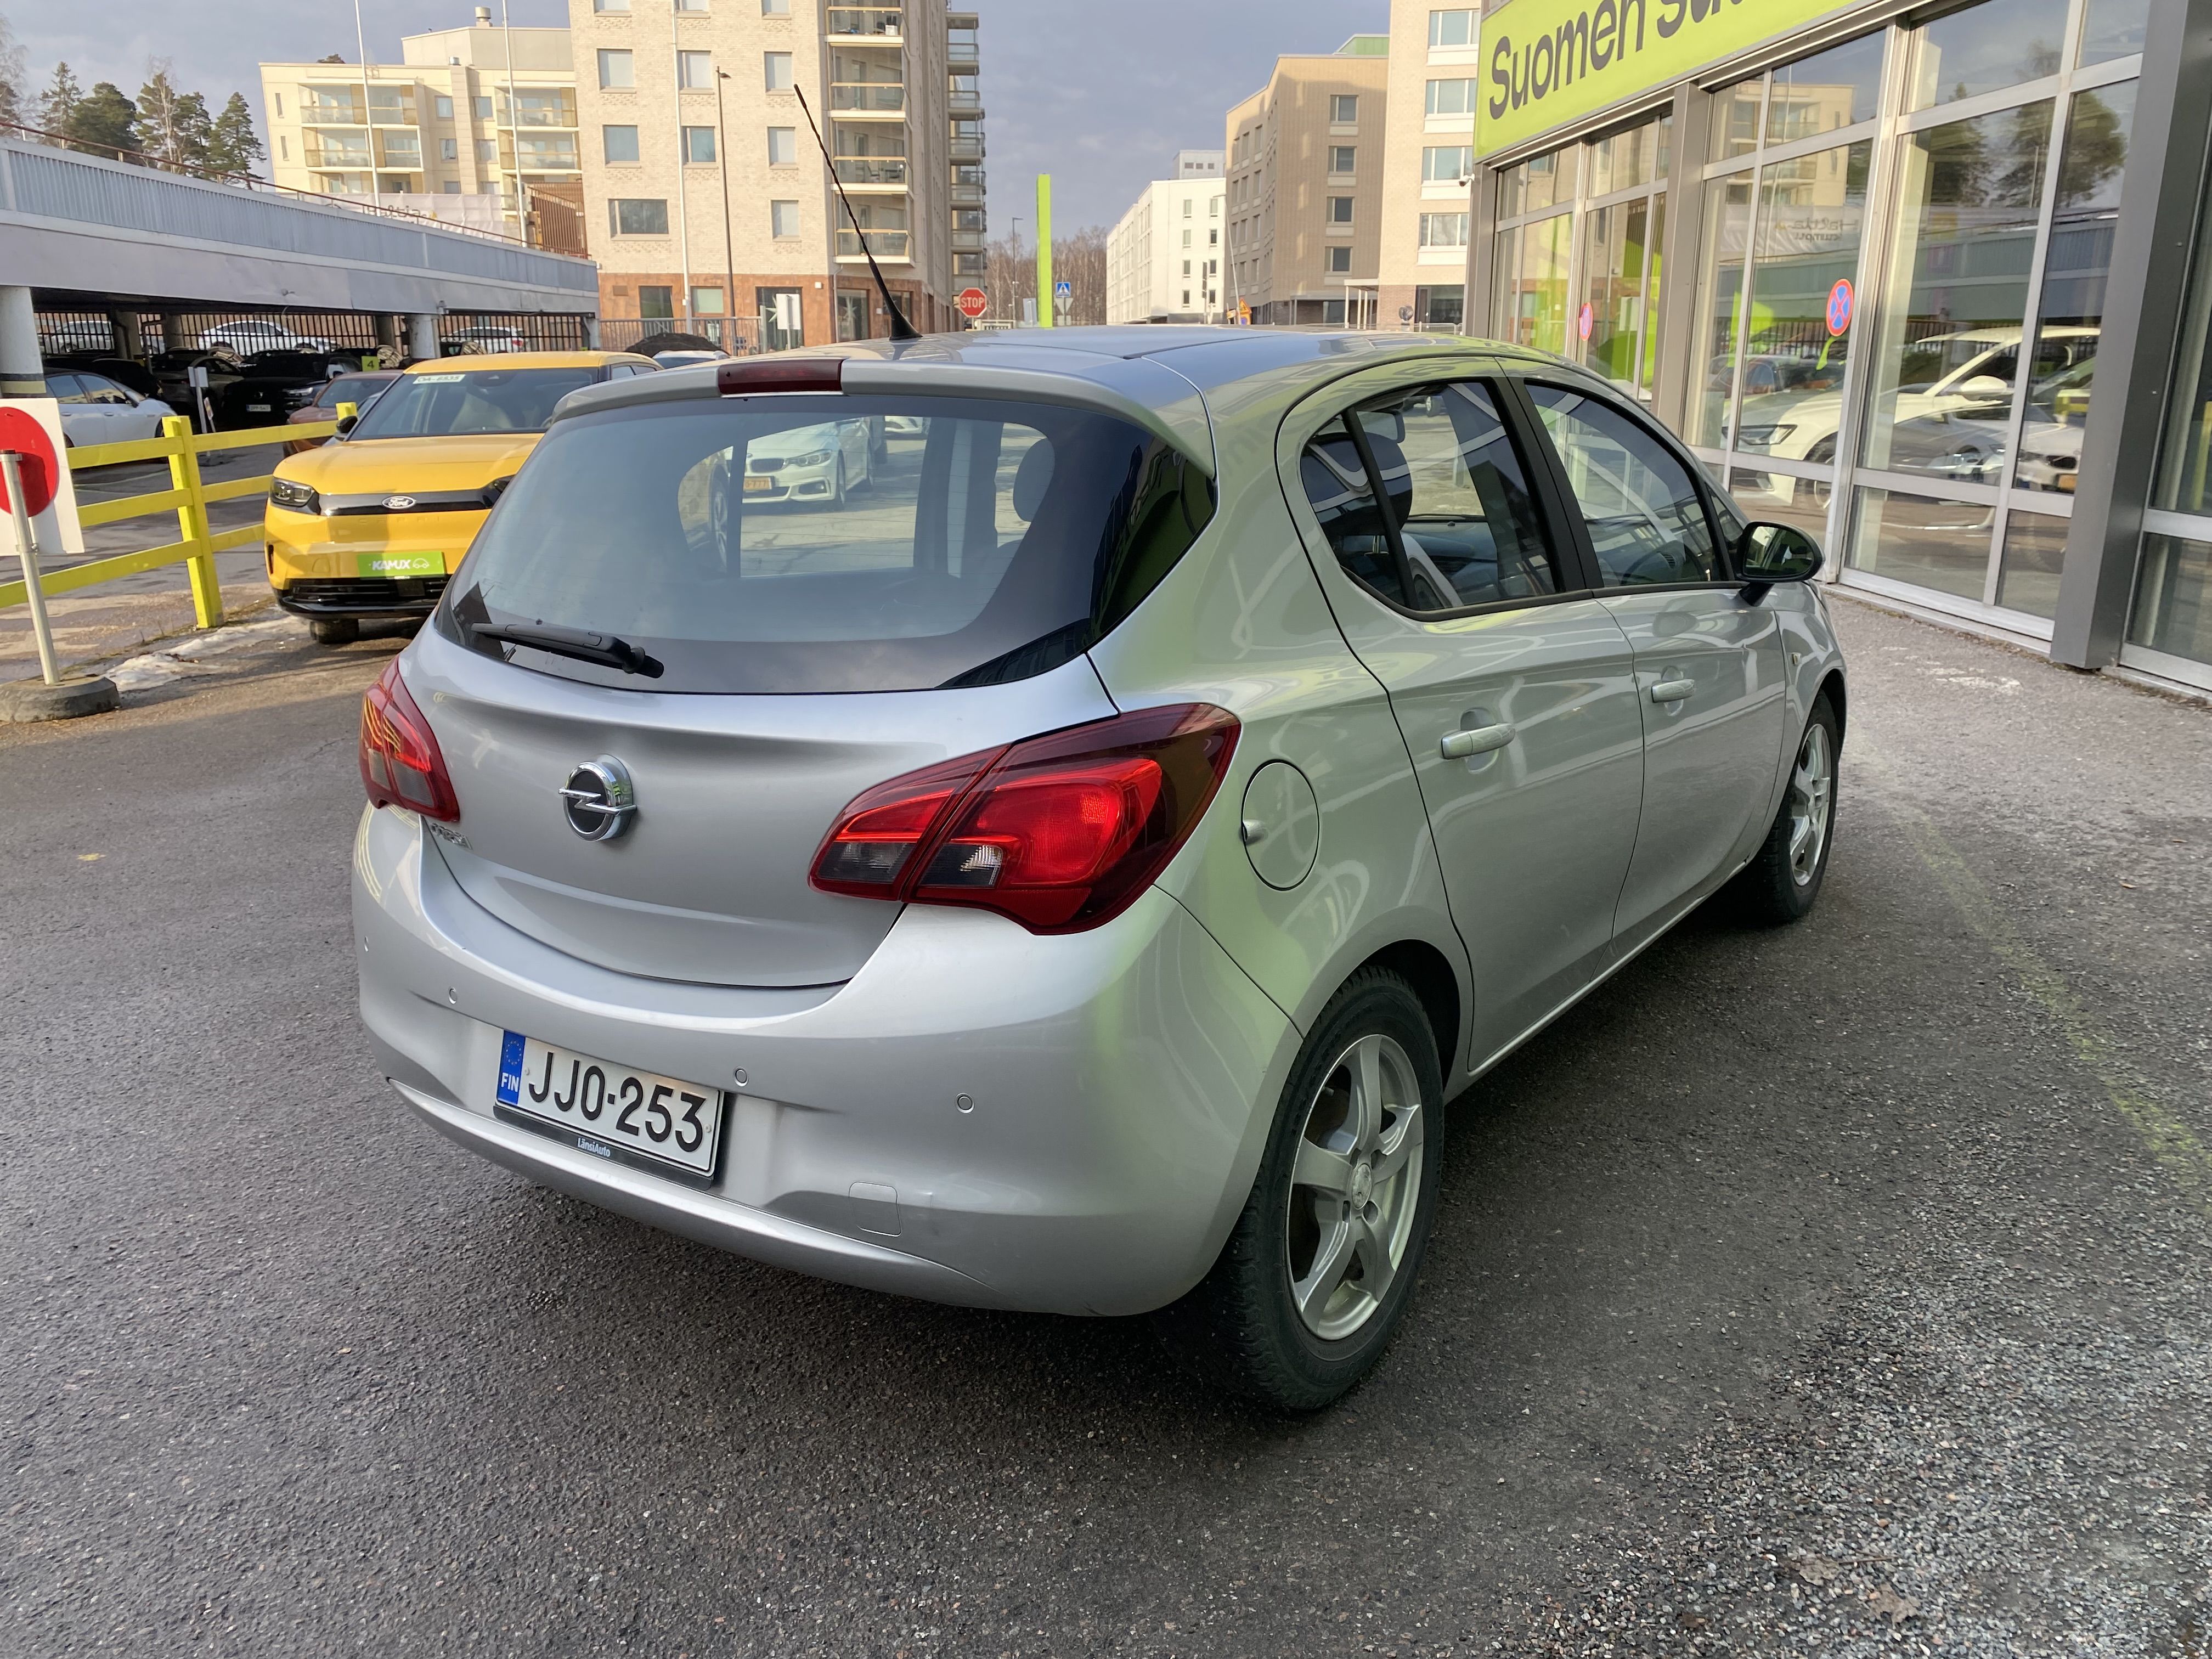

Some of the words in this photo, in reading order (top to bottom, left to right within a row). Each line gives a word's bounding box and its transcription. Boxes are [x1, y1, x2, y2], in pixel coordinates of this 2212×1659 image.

[1489, 0, 1646, 120] Suomen
[960, 297, 985, 308] STOP
[367, 360, 374, 369] 4
[388, 496, 410, 507] Ford
[371, 559, 411, 571] KAMUX
[500, 1071, 520, 1092] FIN
[528, 1051, 707, 1153] JJO-253
[577, 1137, 611, 1158] LänsiAuto
